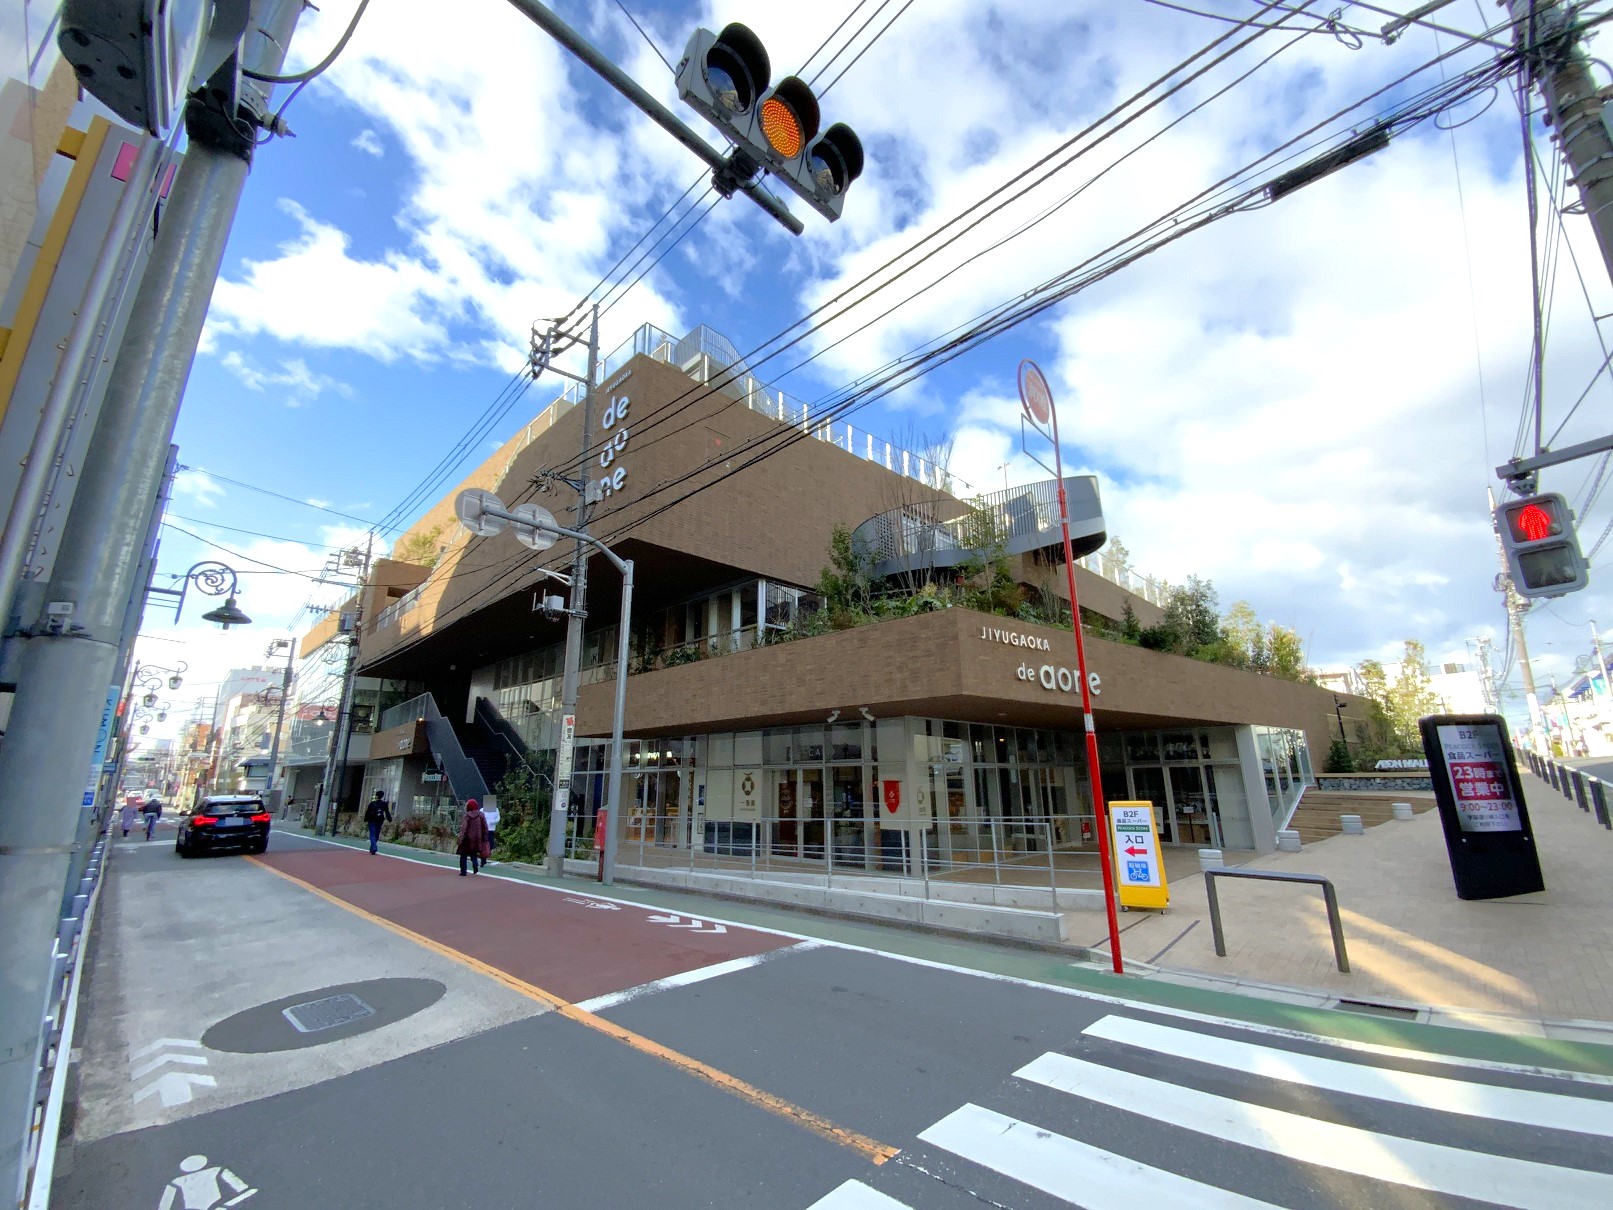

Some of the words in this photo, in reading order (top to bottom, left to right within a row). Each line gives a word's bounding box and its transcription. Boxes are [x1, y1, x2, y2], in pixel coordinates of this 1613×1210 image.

[602, 395, 630, 430] de
[981, 626, 1051, 651] JIYUGAOKA
[1016, 662, 1036, 681] de
[1447, 751, 1500, 760] 食品スーパー
[1453, 765, 1503, 779] 23時まで
[1459, 781, 1504, 797] 営業中
[1123, 810, 1139, 818] B2F
[1125, 835, 1144, 844] 入口
